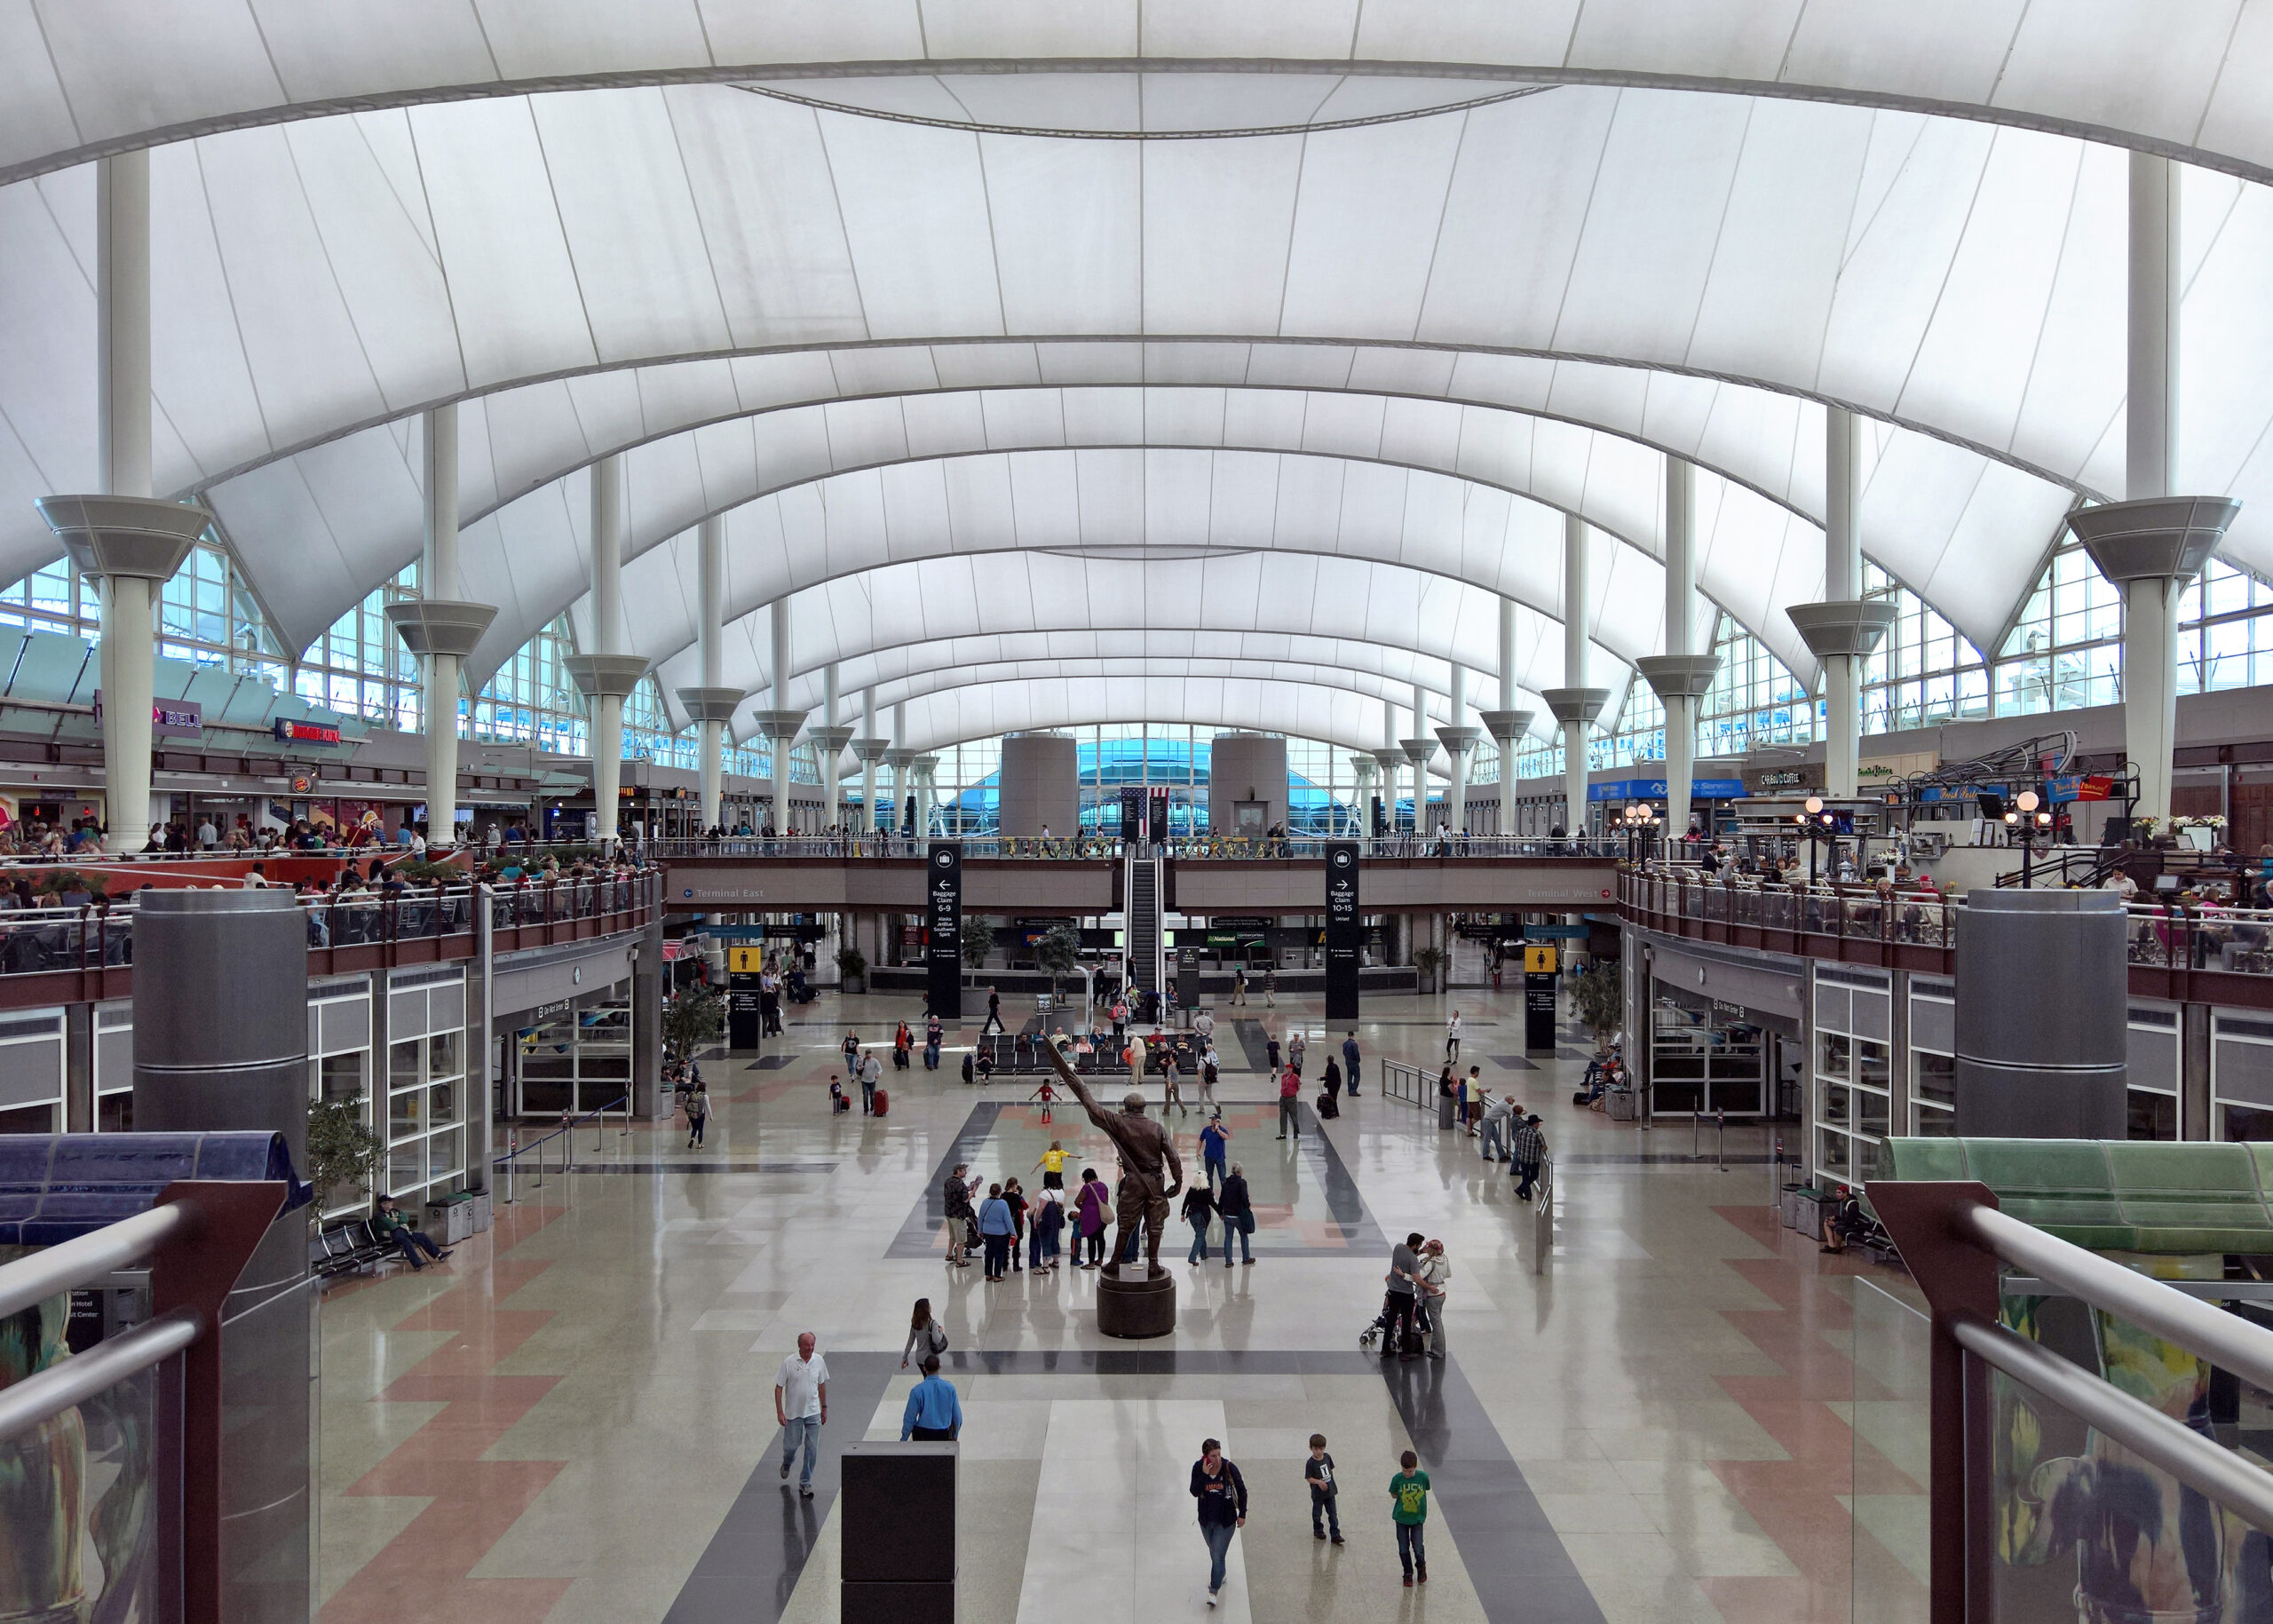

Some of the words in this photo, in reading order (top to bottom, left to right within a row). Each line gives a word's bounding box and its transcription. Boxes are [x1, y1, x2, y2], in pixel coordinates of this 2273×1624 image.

[166, 710, 202, 728] BELL
[293, 725, 321, 740] BURGER
[322, 729, 340, 742] KING
[1761, 773, 1779, 785] CARIBOU
[1784, 772, 1800, 784] COFFEE
[696, 889, 739, 898] Terminal
[742, 889, 764, 898] East
[1526, 889, 1569, 898] Terminal
[1572, 889, 1598, 898] West
[543, 1006, 550, 1015] Do
